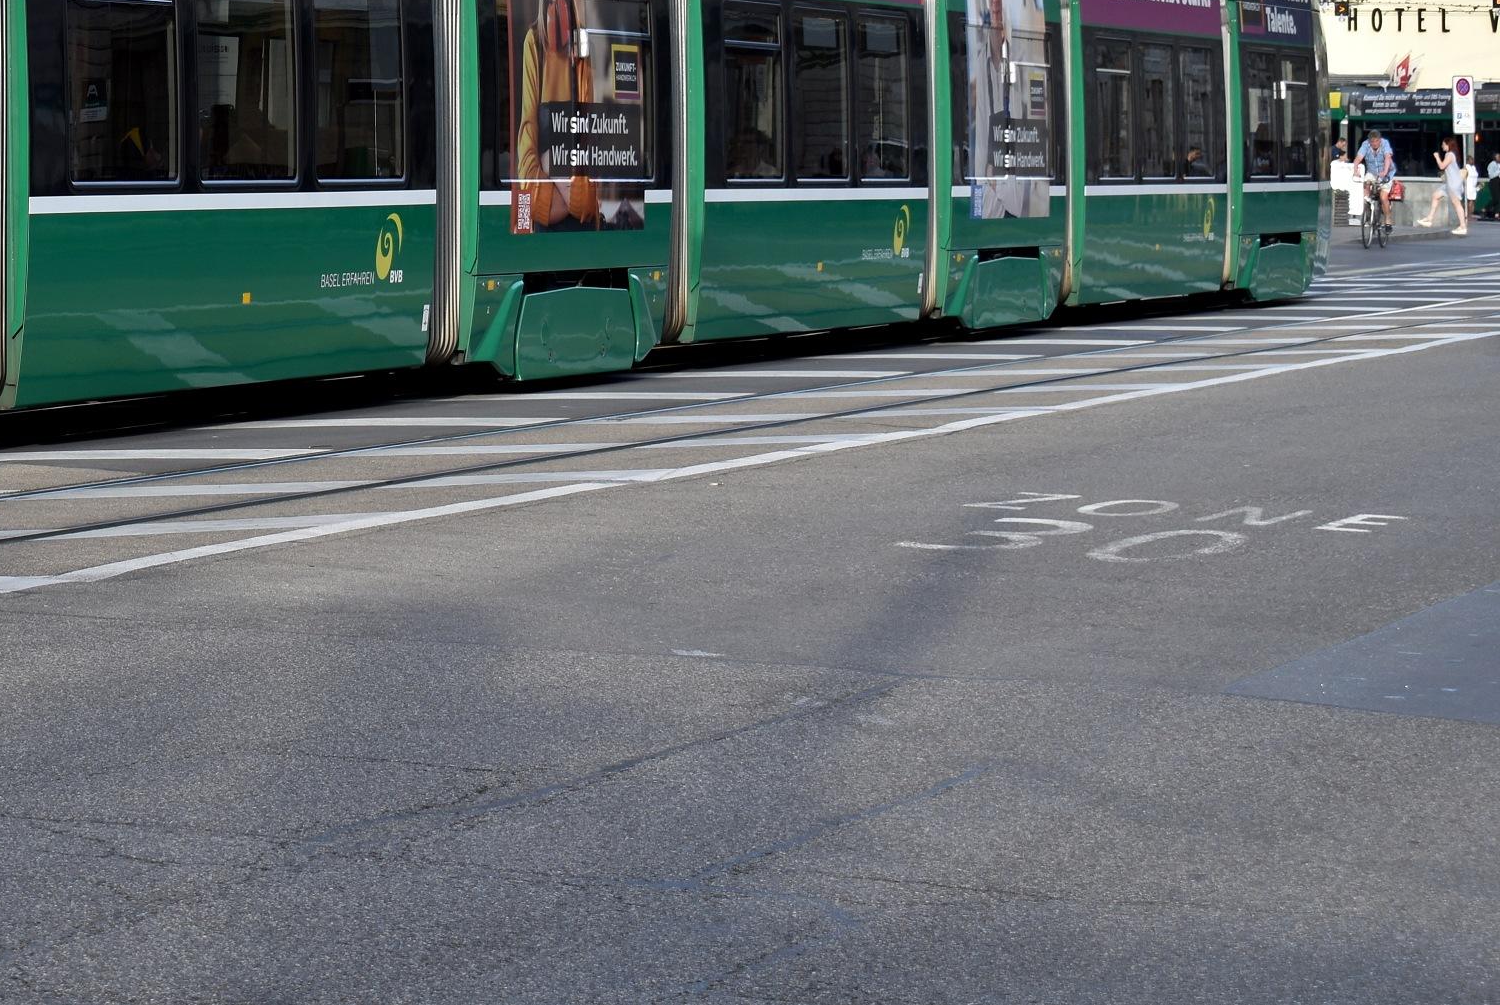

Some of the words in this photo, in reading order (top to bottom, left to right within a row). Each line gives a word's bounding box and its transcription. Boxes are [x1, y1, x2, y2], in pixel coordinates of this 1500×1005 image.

[1265, 5, 1297, 35] Talente.
[1347, 7, 1450, 33] HOTEL
[551, 111, 569, 133] Wir
[591, 113, 629, 135] Zukunft.
[993, 125, 1003, 142] Wir
[1017, 127, 1040, 143] Zukunft.
[551, 144, 569, 166] Wir
[591, 145, 638, 167] Handwerk.
[993, 150, 1003, 167] Wir
[1017, 152, 1045, 167] Handwerk.
[320, 272, 341, 288] BASEL
[341, 270, 375, 286] ERFAHREN
[389, 269, 404, 284] BVB
[961, 491, 1408, 534] ZONE
[894, 516, 1248, 563] 30
